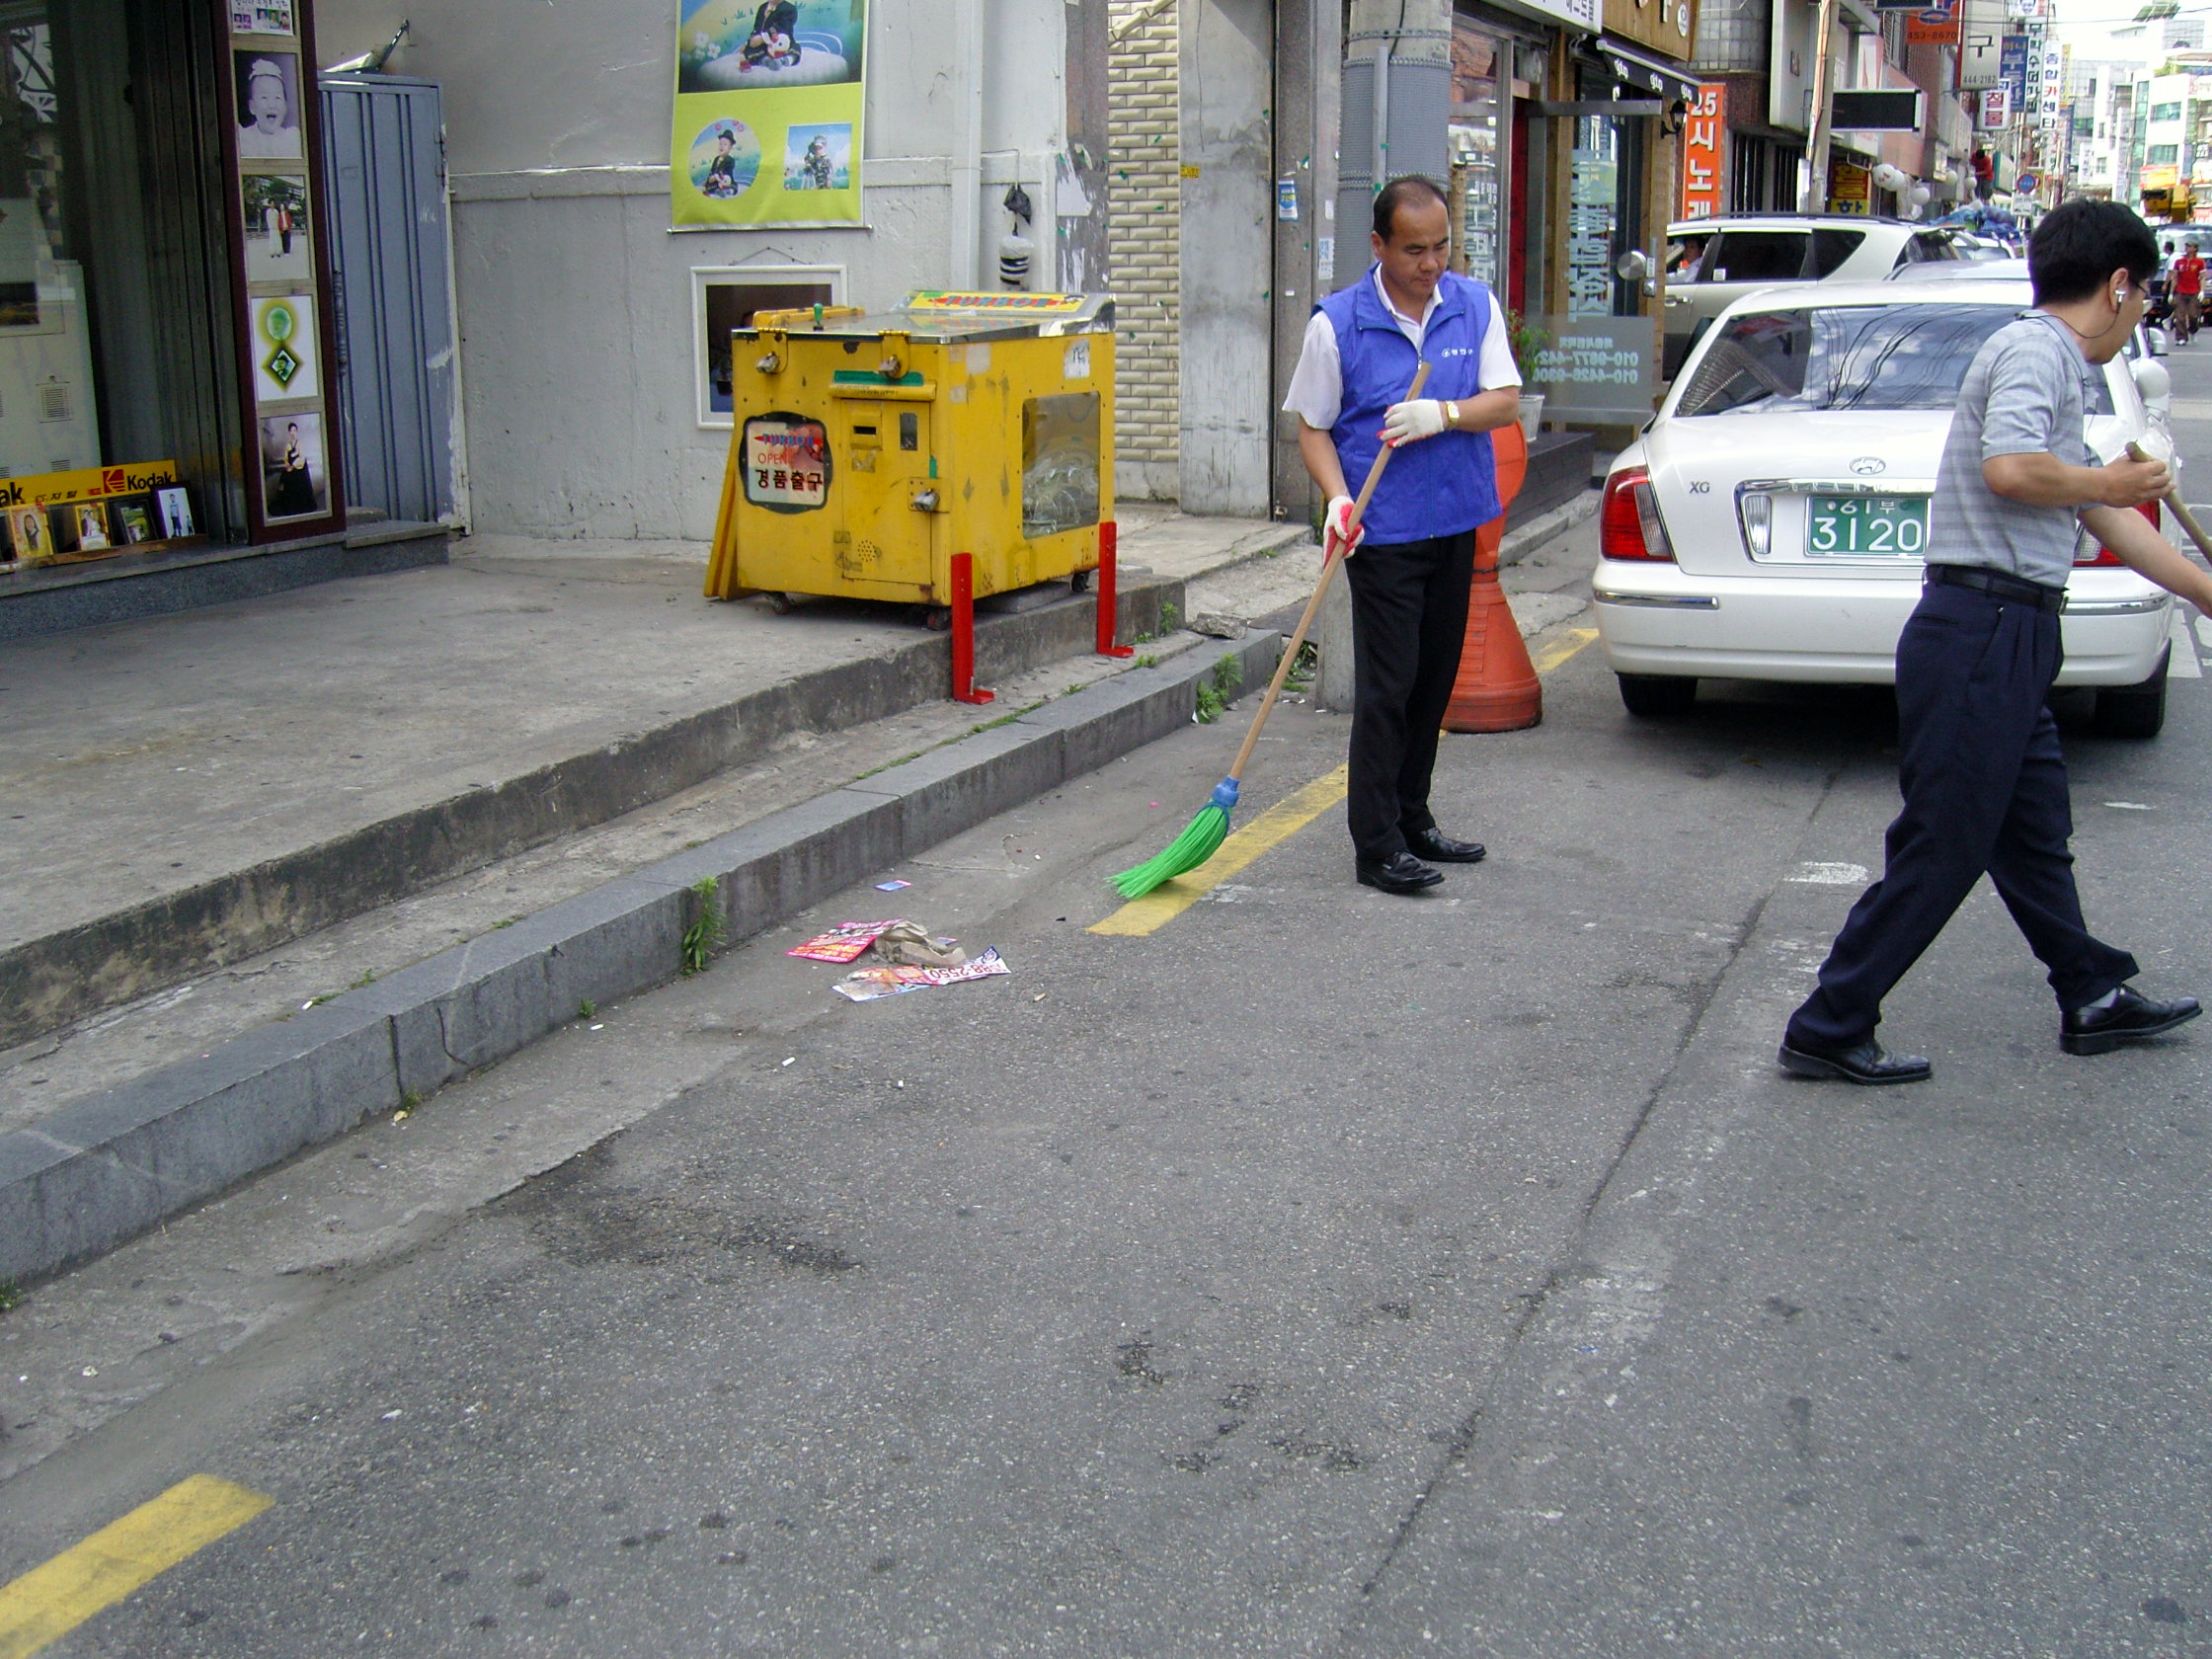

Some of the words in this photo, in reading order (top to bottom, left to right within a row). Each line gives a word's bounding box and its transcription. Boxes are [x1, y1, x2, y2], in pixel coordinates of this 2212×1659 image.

[758, 452, 788, 465] OPEN
[127, 471, 173, 491] Kodak
[755, 468, 824, 493] 경품출구
[1689, 481, 1710, 494] XG
[1812, 516, 1923, 551] 3120
